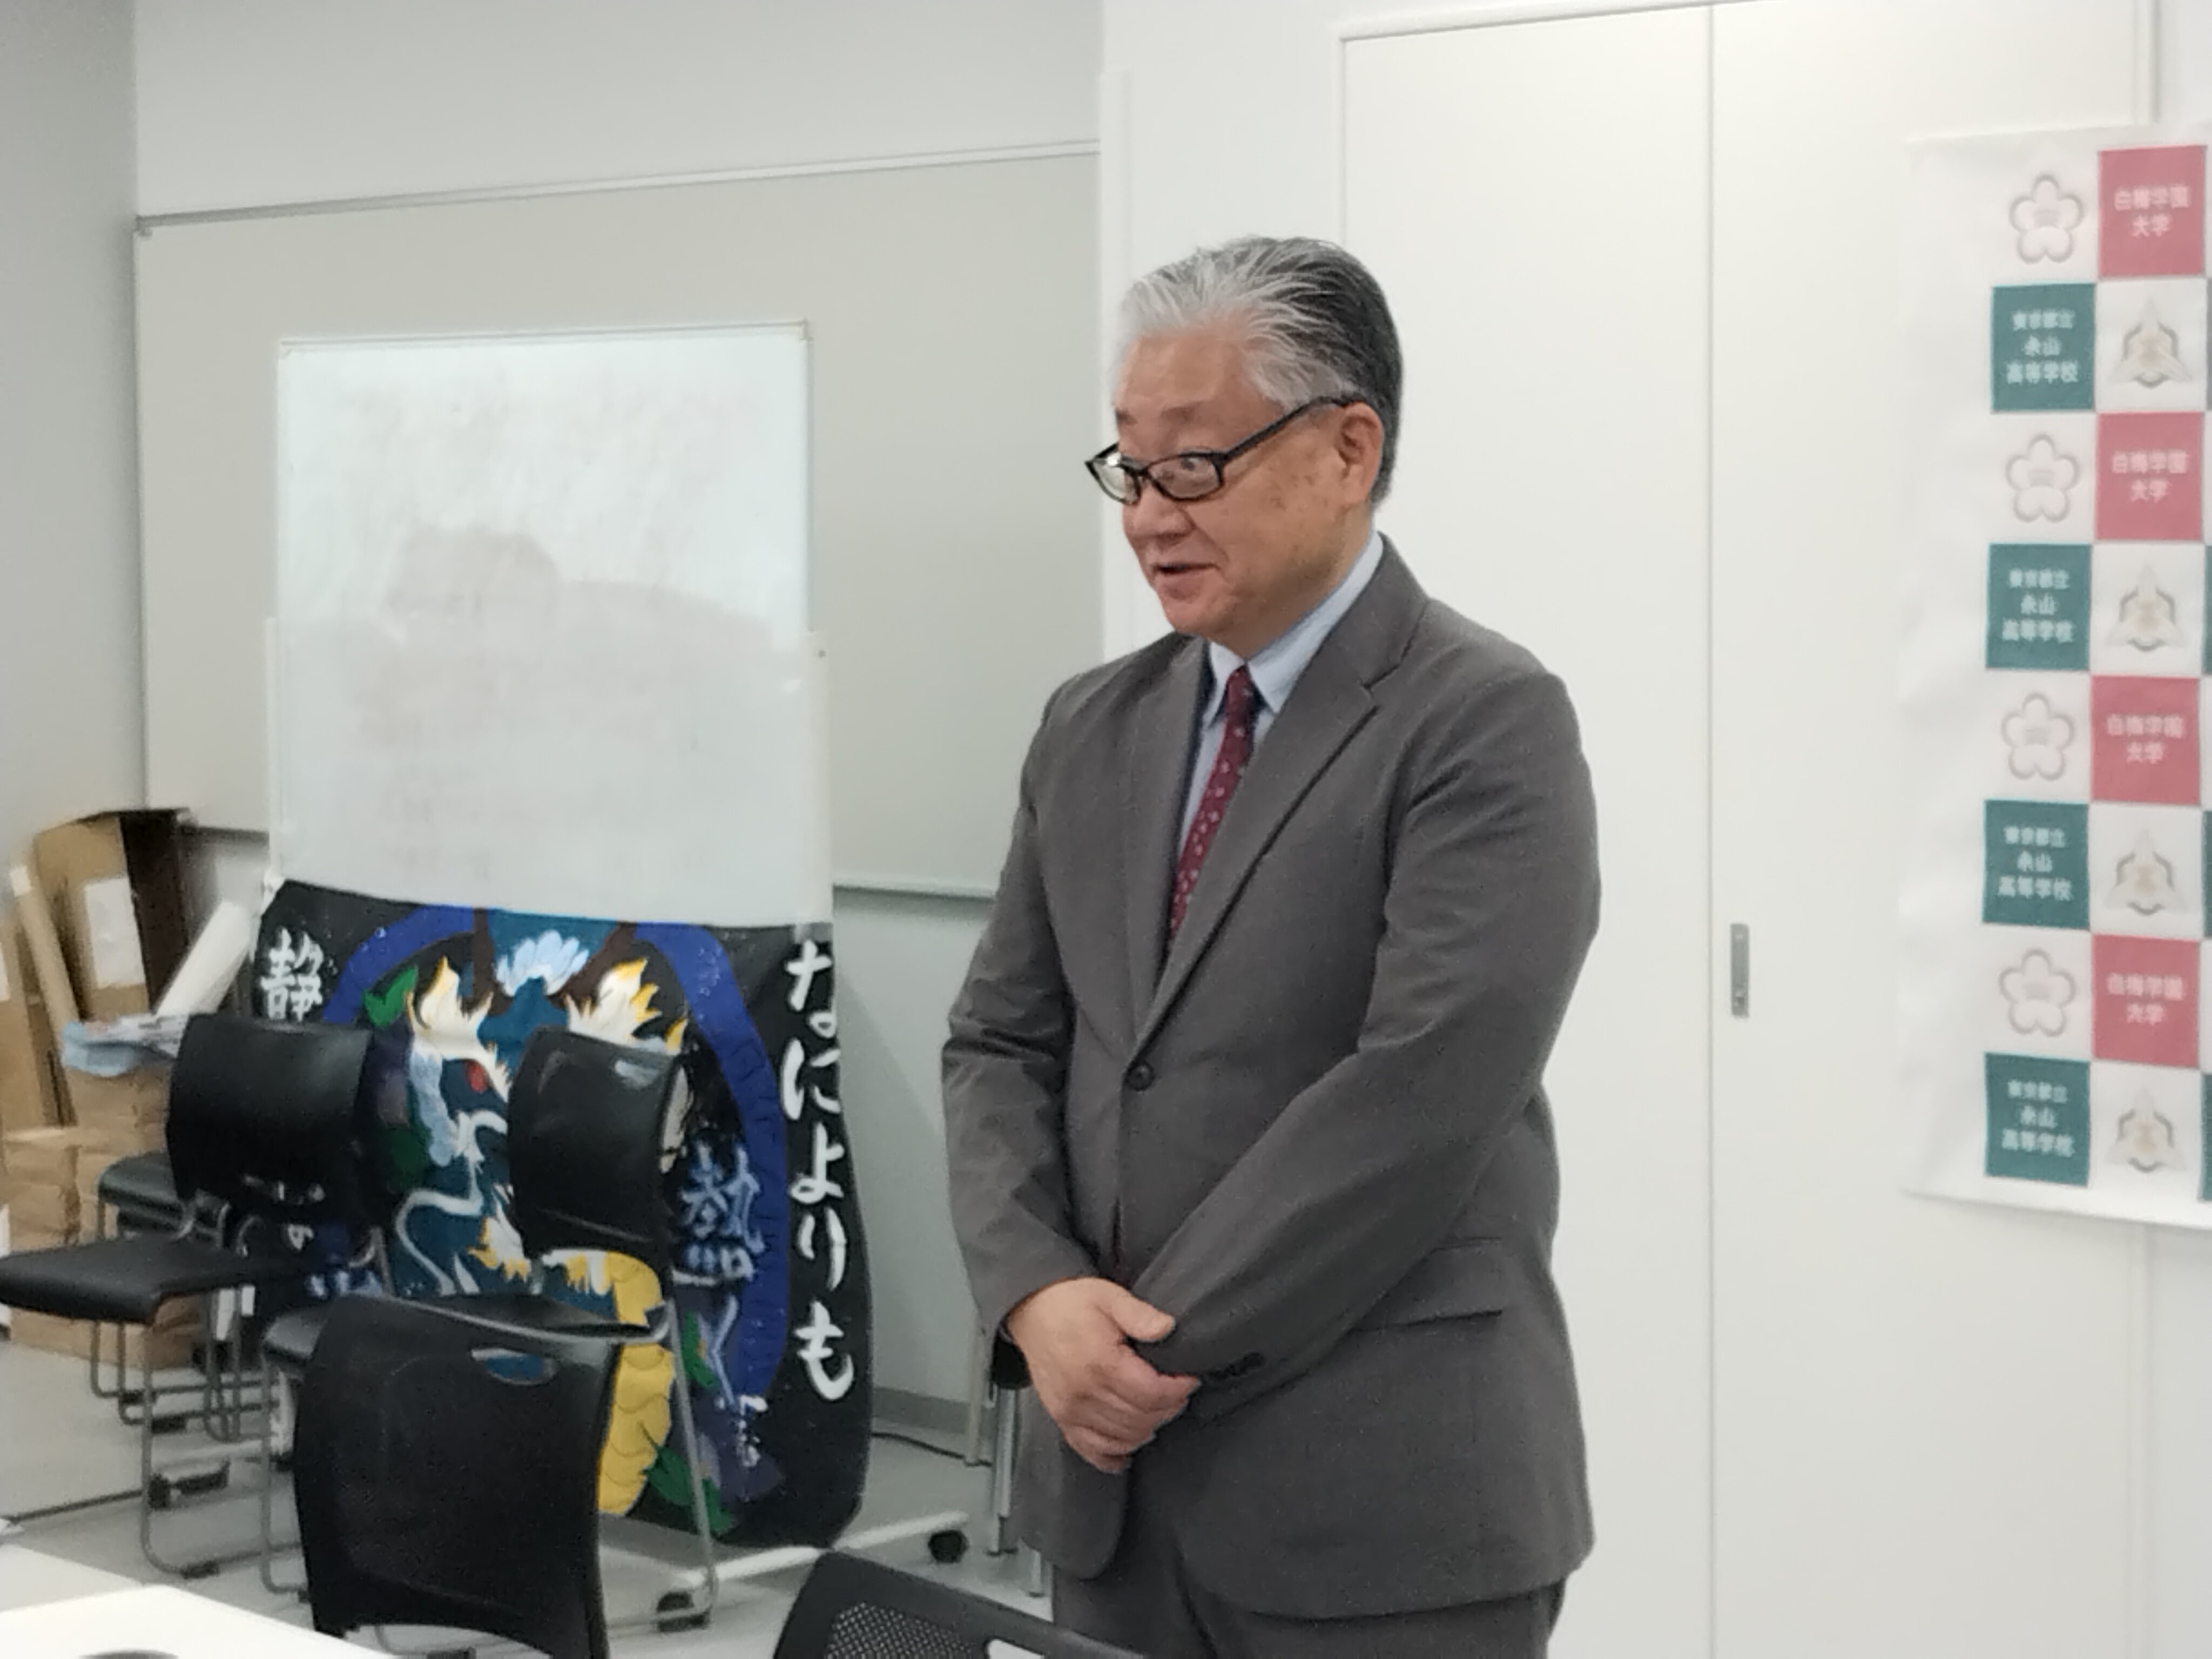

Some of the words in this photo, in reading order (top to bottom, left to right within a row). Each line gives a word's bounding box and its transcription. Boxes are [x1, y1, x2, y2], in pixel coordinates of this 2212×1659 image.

[780, 939, 854, 1400] なによりも
